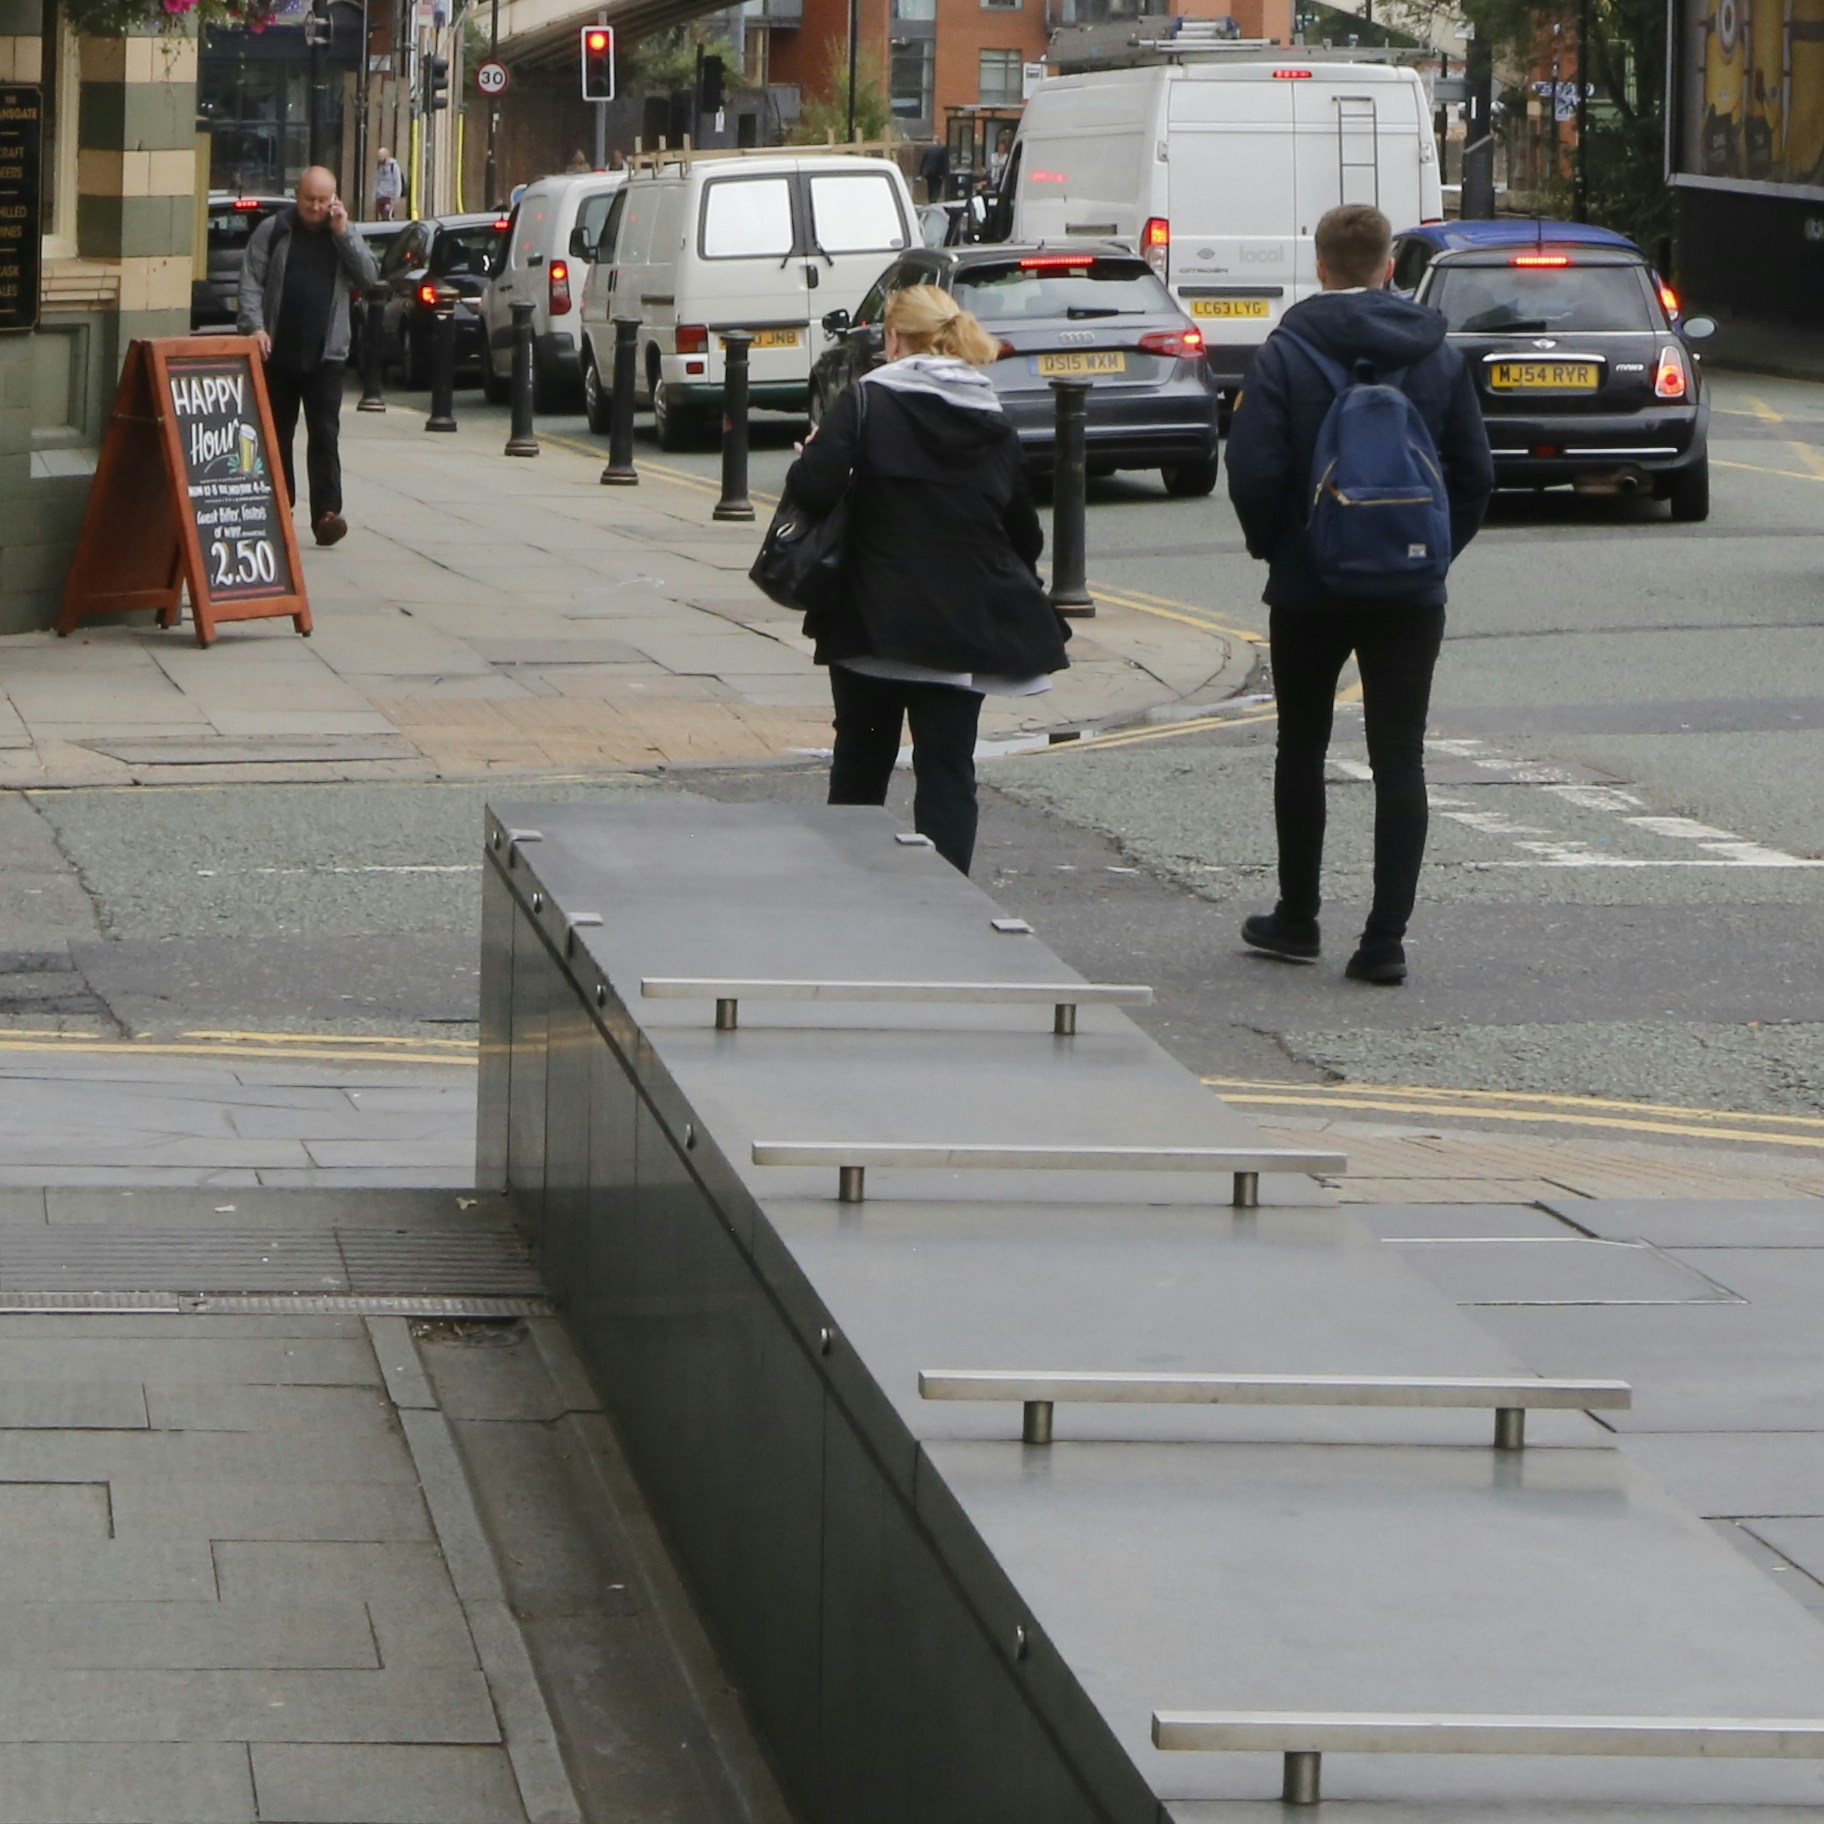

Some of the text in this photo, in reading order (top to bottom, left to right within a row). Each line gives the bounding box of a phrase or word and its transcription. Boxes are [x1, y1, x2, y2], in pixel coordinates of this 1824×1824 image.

[480, 71, 503, 85] 30
[1239, 244, 1284, 263] local
[1195, 301, 1261, 315] LC63 LYG
[766, 331, 796, 345] JNB
[1086, 354, 1118, 369] WXM
[1499, 366, 1589, 383] MJ54 RYR
[170, 375, 245, 417] HAPPY
[190, 419, 240, 466] Hour
